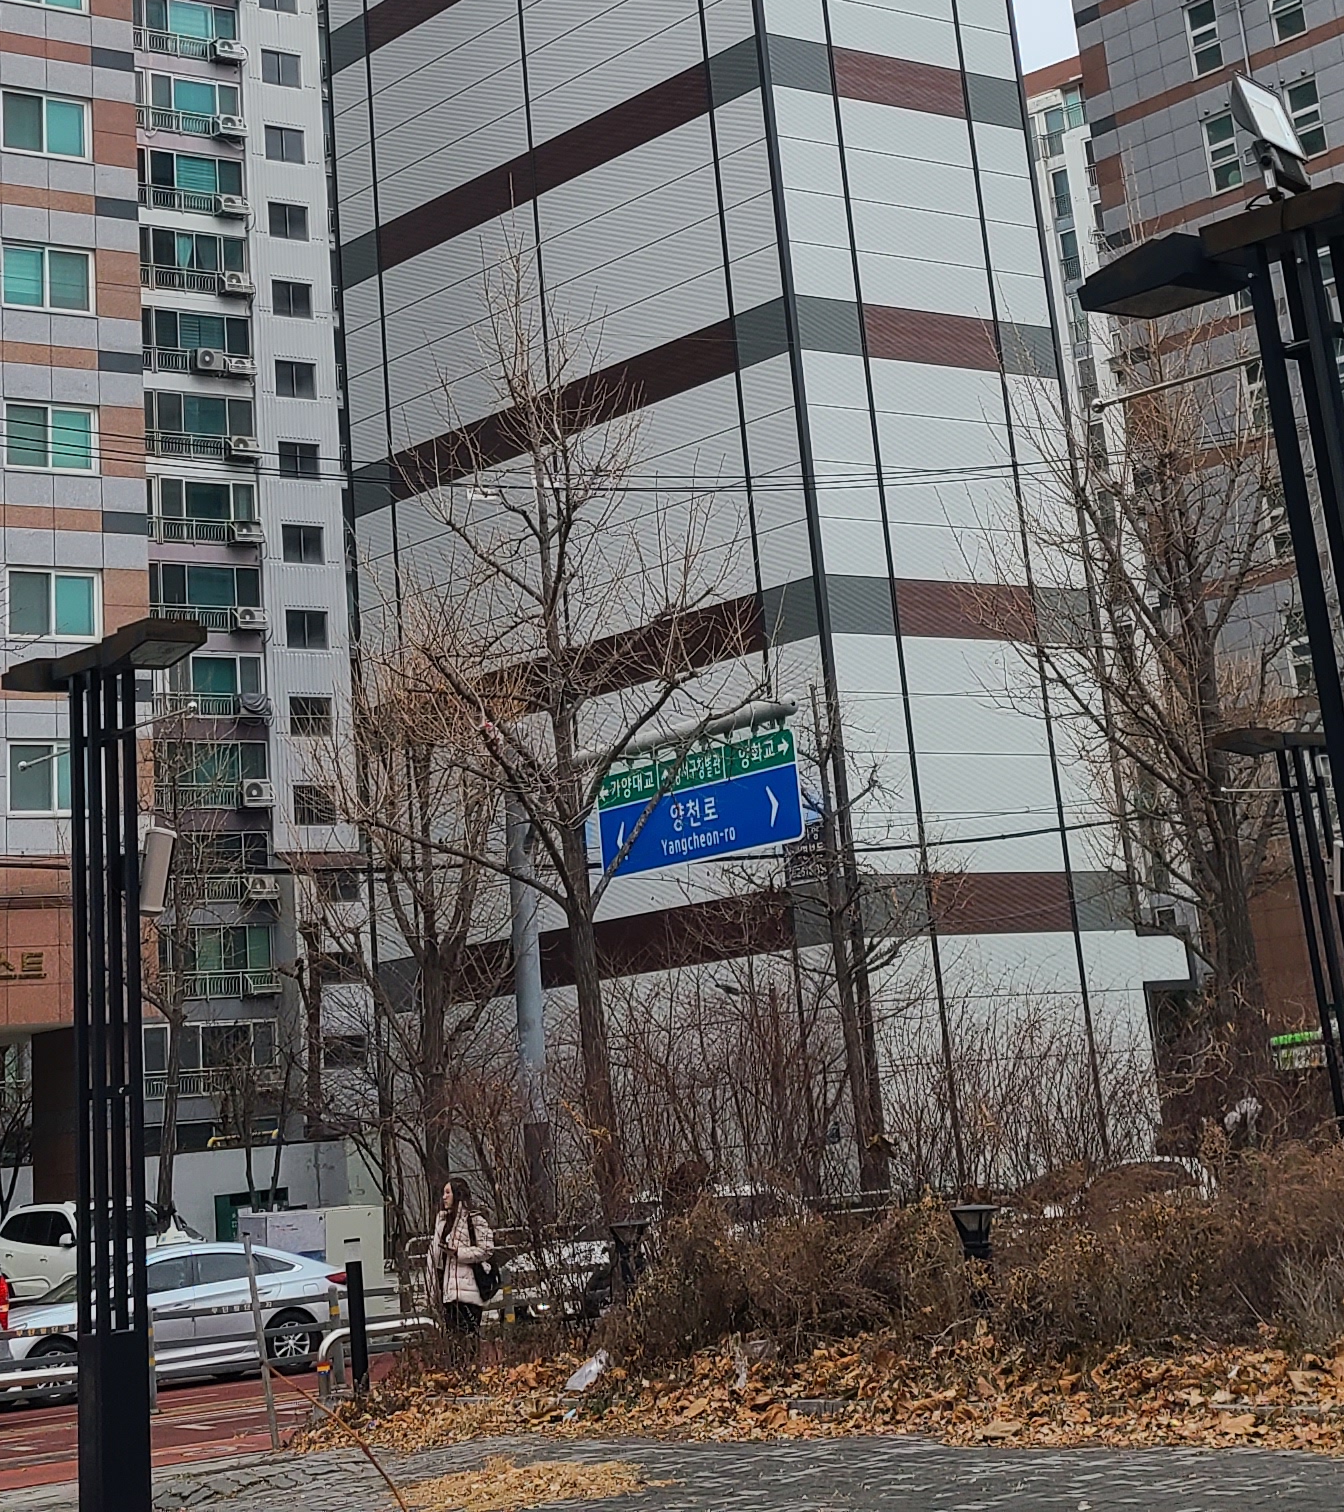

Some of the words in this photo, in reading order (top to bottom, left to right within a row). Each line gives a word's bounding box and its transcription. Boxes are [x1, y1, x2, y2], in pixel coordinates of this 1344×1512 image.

[609, 771, 655, 799] 가양대교
[738, 739, 776, 769] 양화교
[669, 796, 719, 832] 양천로
[660, 826, 736, 856] Yangcheon-ro
